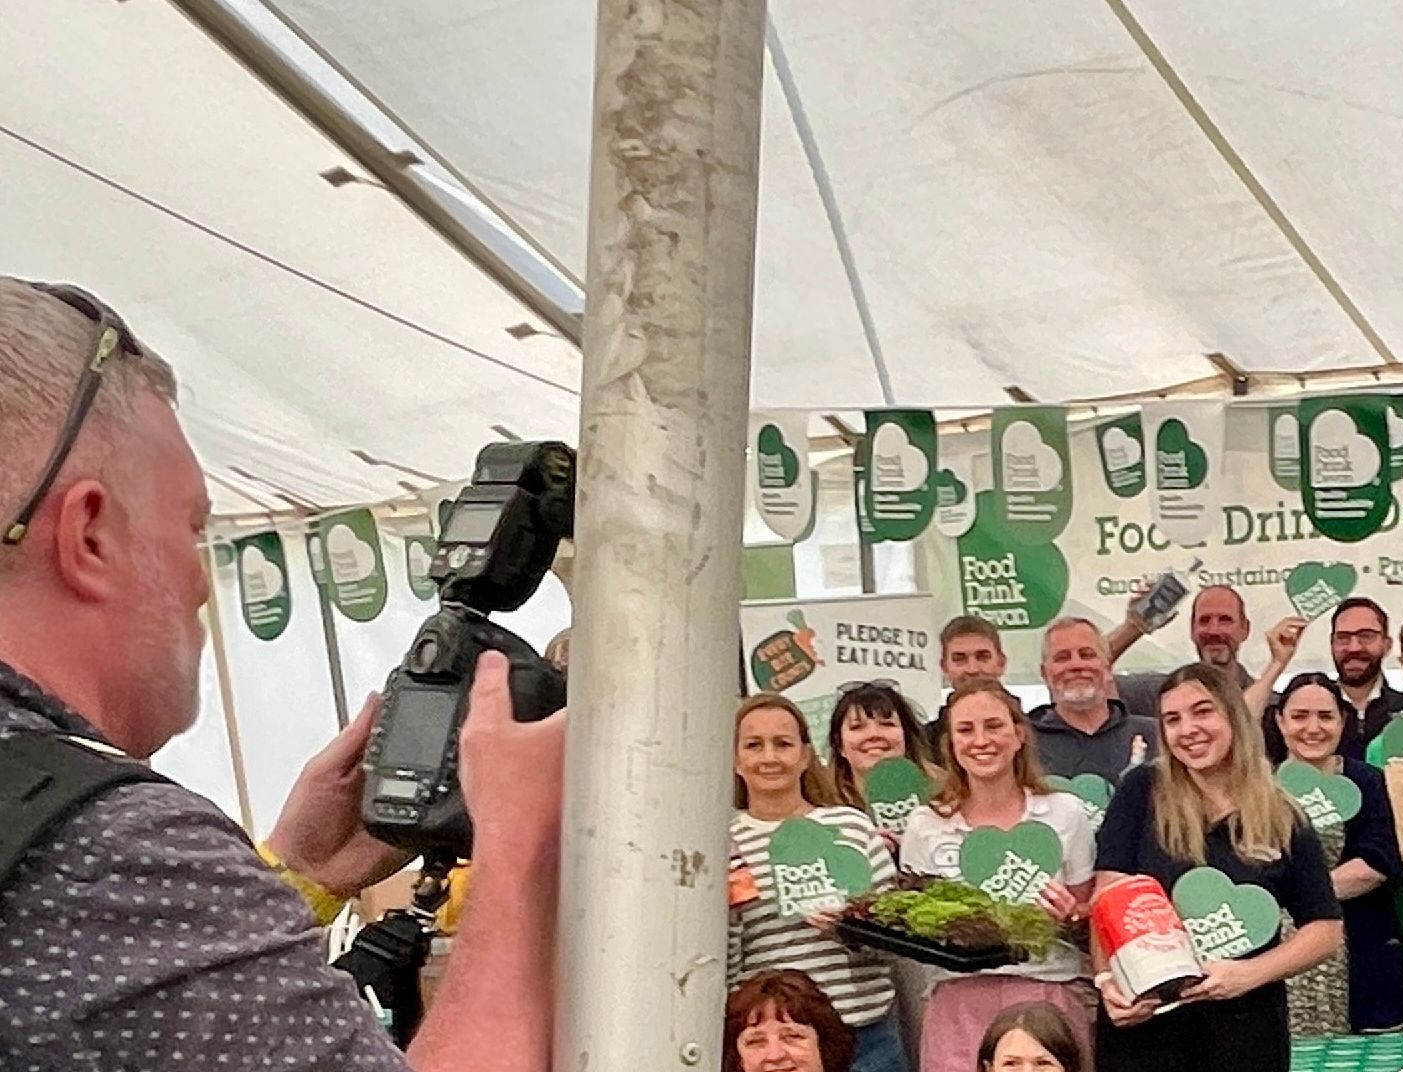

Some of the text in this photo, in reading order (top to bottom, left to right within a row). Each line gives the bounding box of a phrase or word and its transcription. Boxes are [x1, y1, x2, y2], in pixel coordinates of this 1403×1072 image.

[1222, 501, 1322, 545] Drin
[962, 553, 1017, 580] Food
[965, 578, 1027, 606] Drink
[836, 622, 929, 649] PLEDGE TO
[836, 645, 869, 665] EAT
[872, 647, 927, 671] LOCAL
[870, 793, 920, 820] Food
[774, 858, 828, 882] Food
[979, 850, 1022, 896] Food
[778, 876, 838, 899] Drink
[1183, 903, 1236, 934] Food
[1190, 919, 1247, 951] Drink
